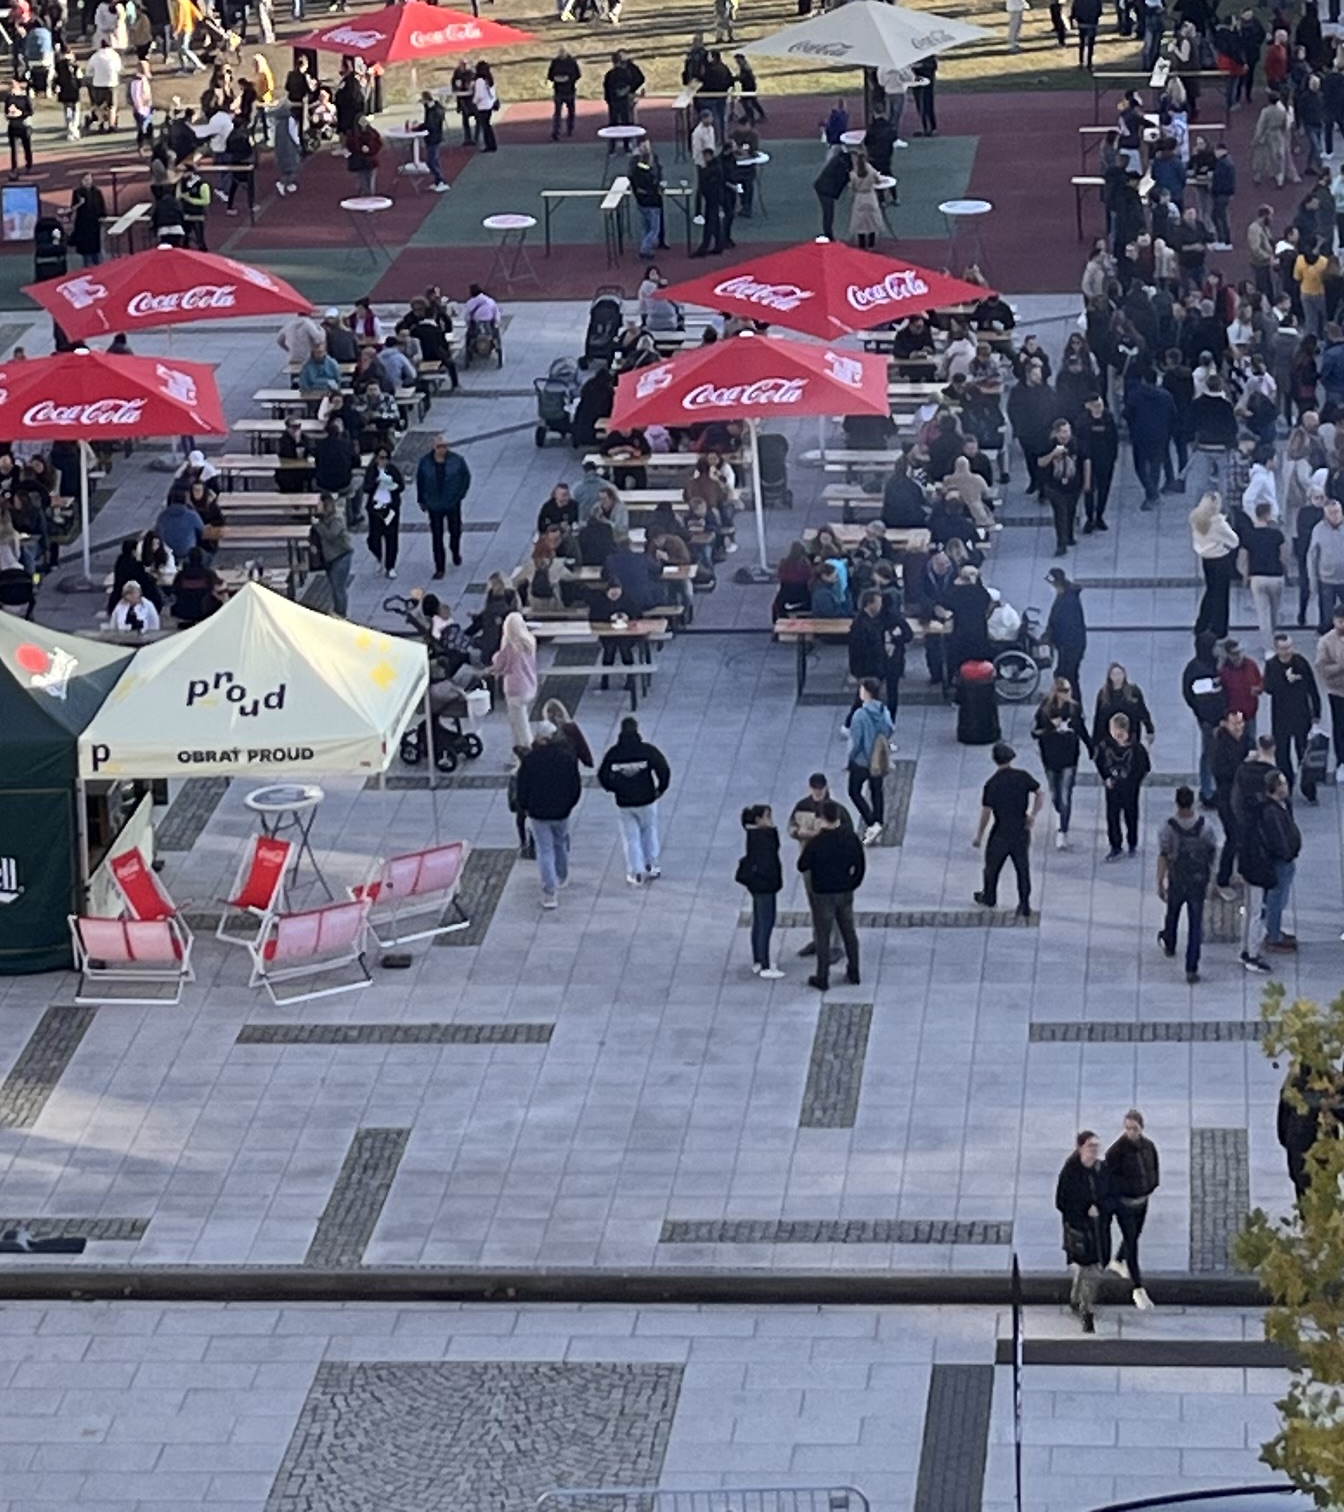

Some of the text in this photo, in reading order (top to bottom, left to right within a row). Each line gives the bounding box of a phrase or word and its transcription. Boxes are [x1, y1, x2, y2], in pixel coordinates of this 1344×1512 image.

[127, 285, 238, 317] Coca-Cola
[846, 269, 929, 311] Coca-Cola
[682, 378, 810, 410] Coca-Cola
[22, 398, 148, 427] Coca-Cola
[186, 670, 287, 717] proud
[91, 743, 111, 772] p
[247, 747, 315, 763] PROUD
